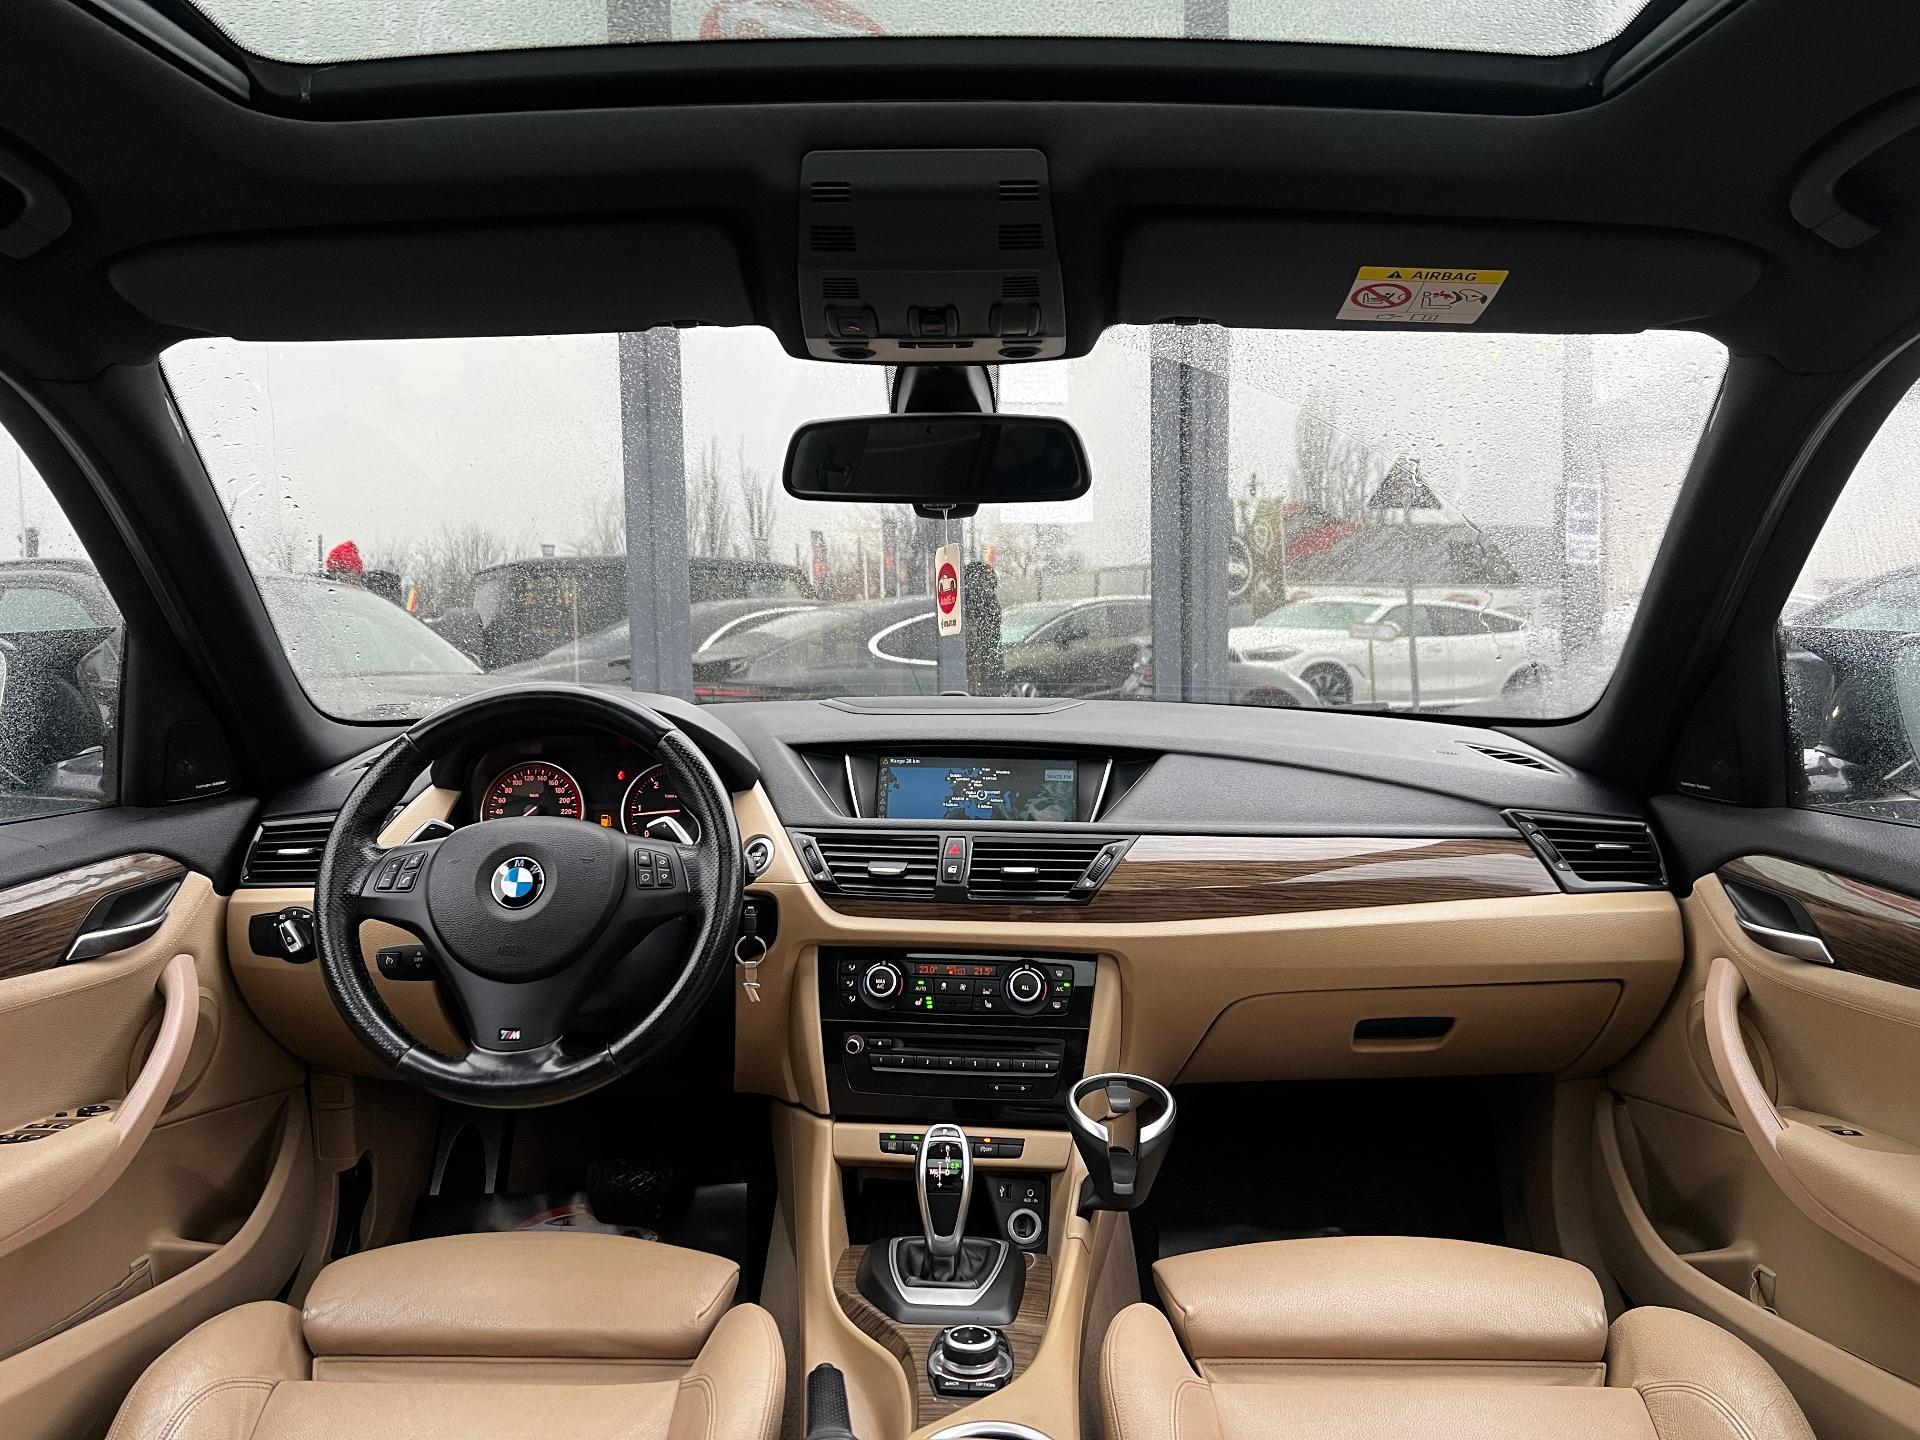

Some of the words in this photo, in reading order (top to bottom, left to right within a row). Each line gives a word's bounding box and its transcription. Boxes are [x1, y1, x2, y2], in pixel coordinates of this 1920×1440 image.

[1411, 271, 1477, 281] AIRBAG
[653, 781, 659, 789] 2
[644, 829, 650, 838] 0
